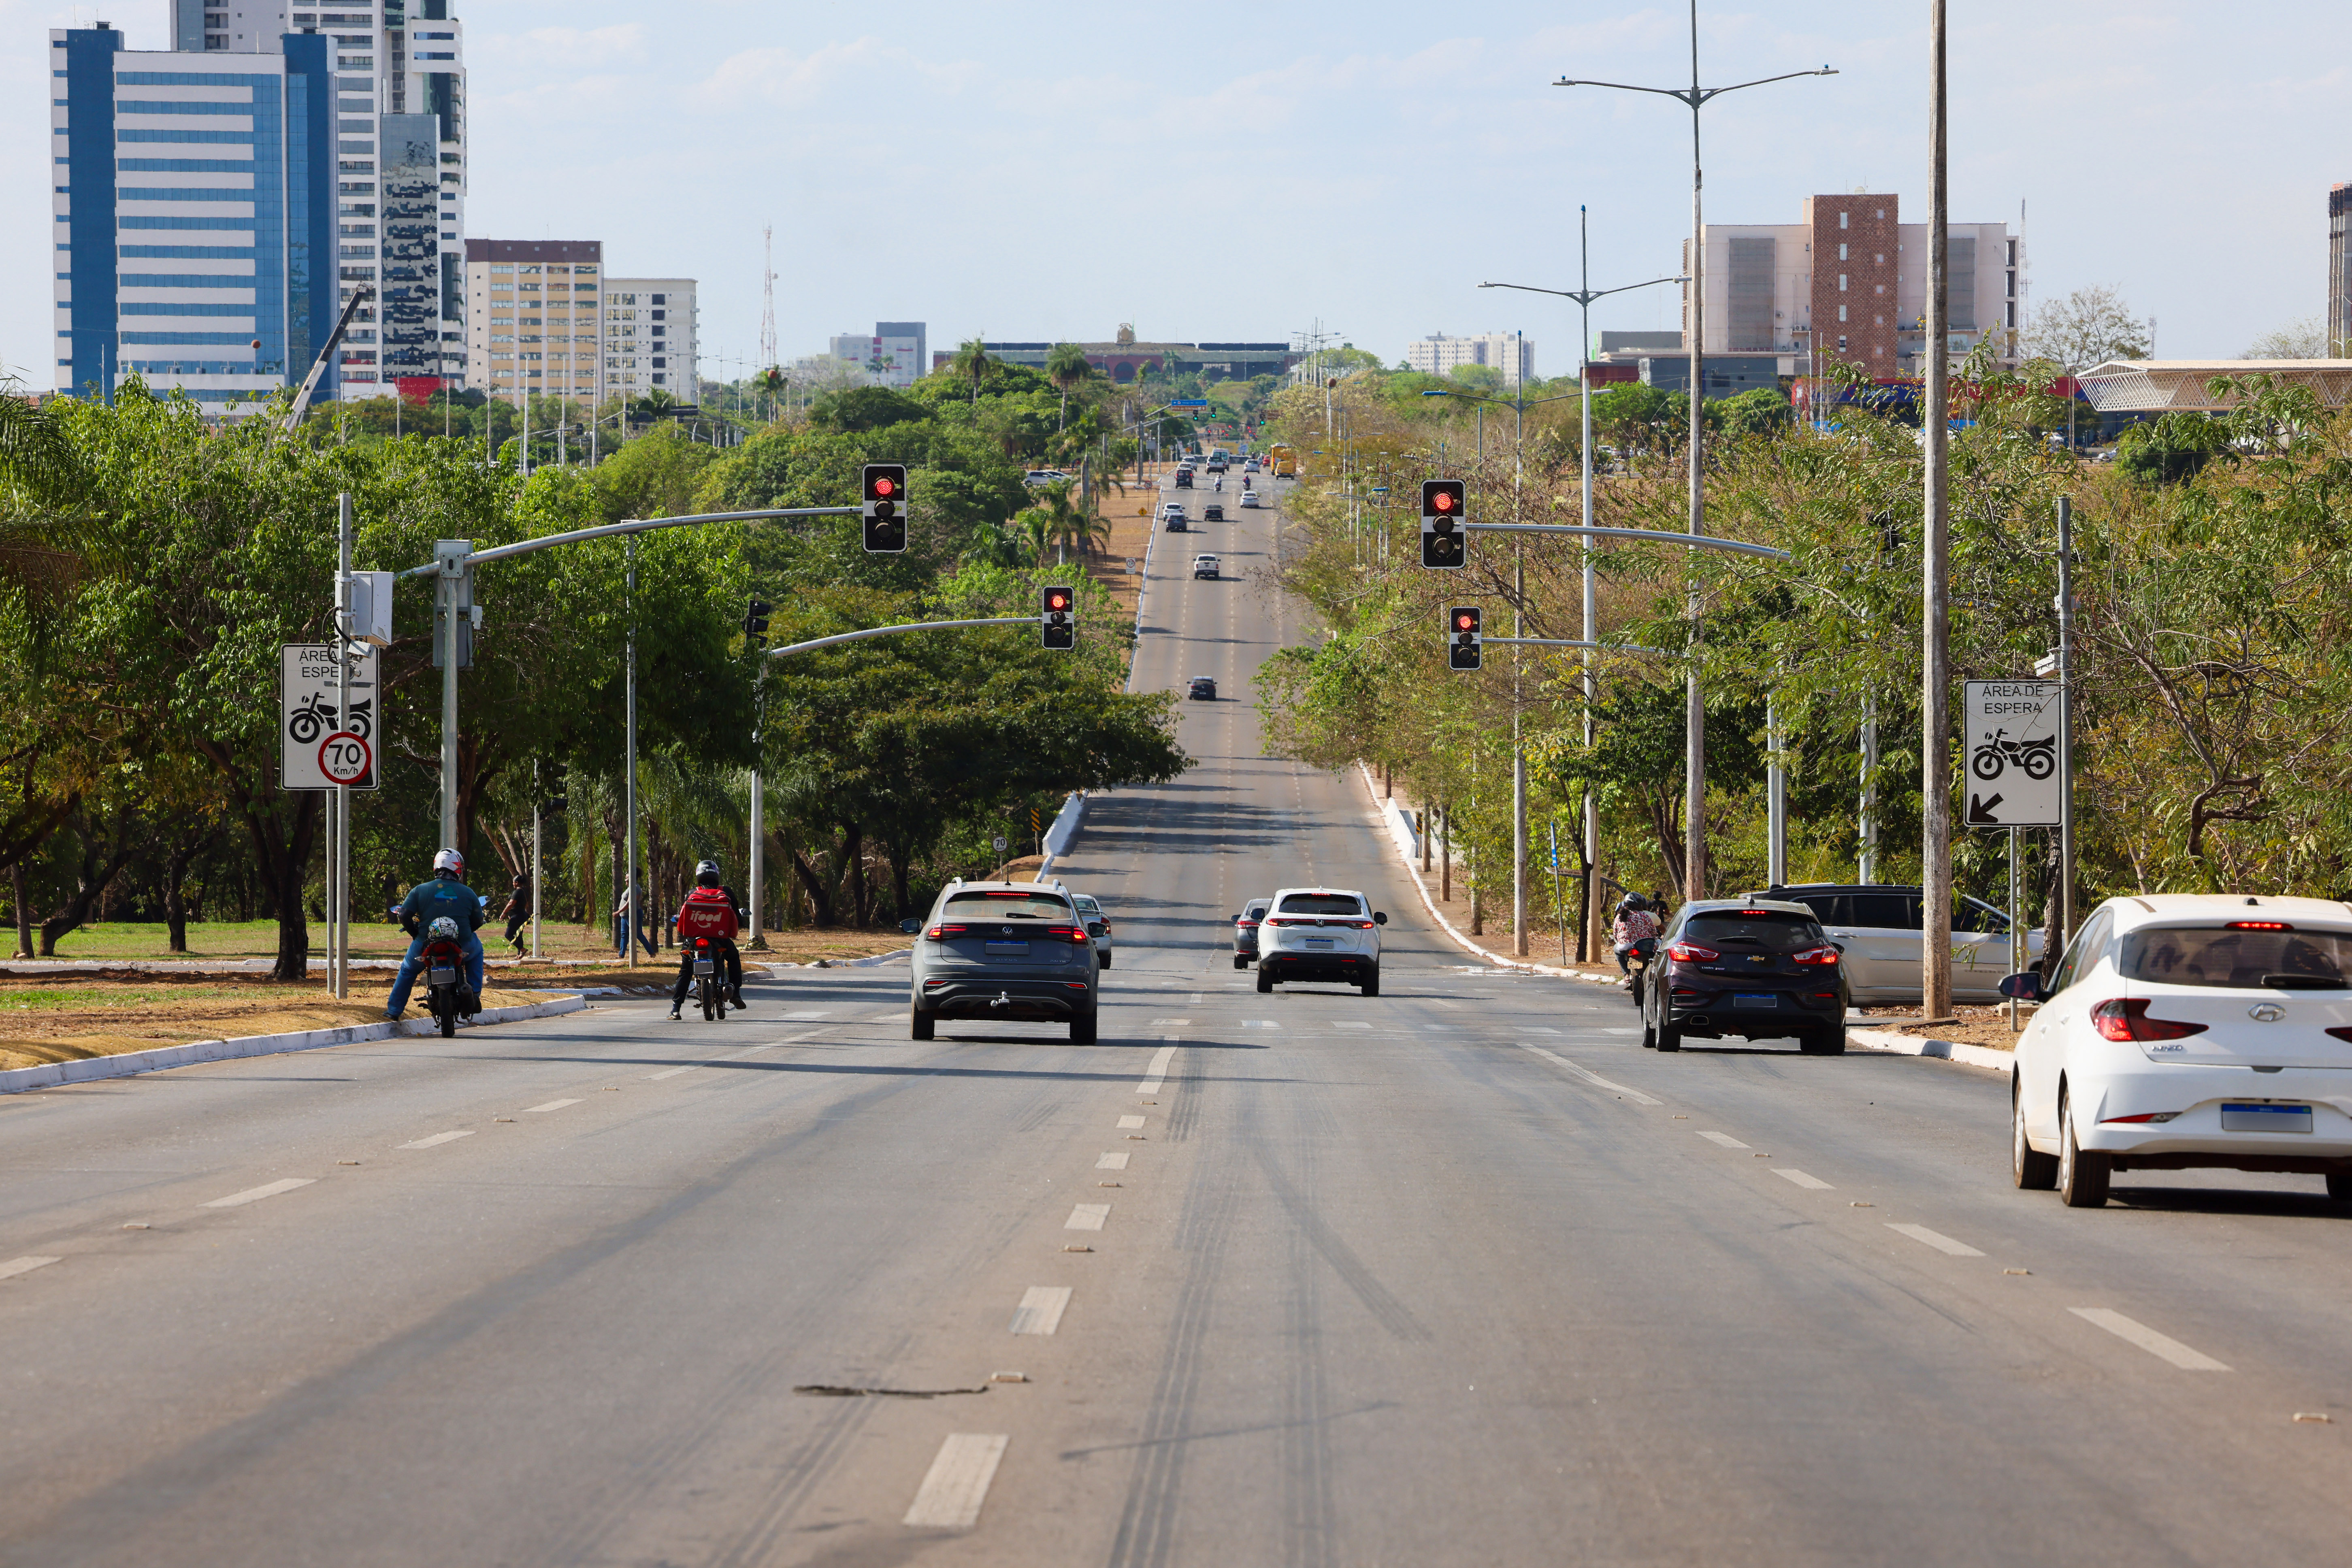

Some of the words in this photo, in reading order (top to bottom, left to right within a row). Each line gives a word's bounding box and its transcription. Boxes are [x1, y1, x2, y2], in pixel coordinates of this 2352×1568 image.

[299, 648, 338, 661] ÁREA
[302, 667, 339, 677] ESPE
[1982, 683, 2022, 697] ÁREA
[2025, 686, 2044, 696] DE
[1985, 703, 2042, 714] ESPERA
[328, 744, 360, 765] 70
[334, 766, 358, 775] Km/h
[996, 838, 1005, 847] 70
